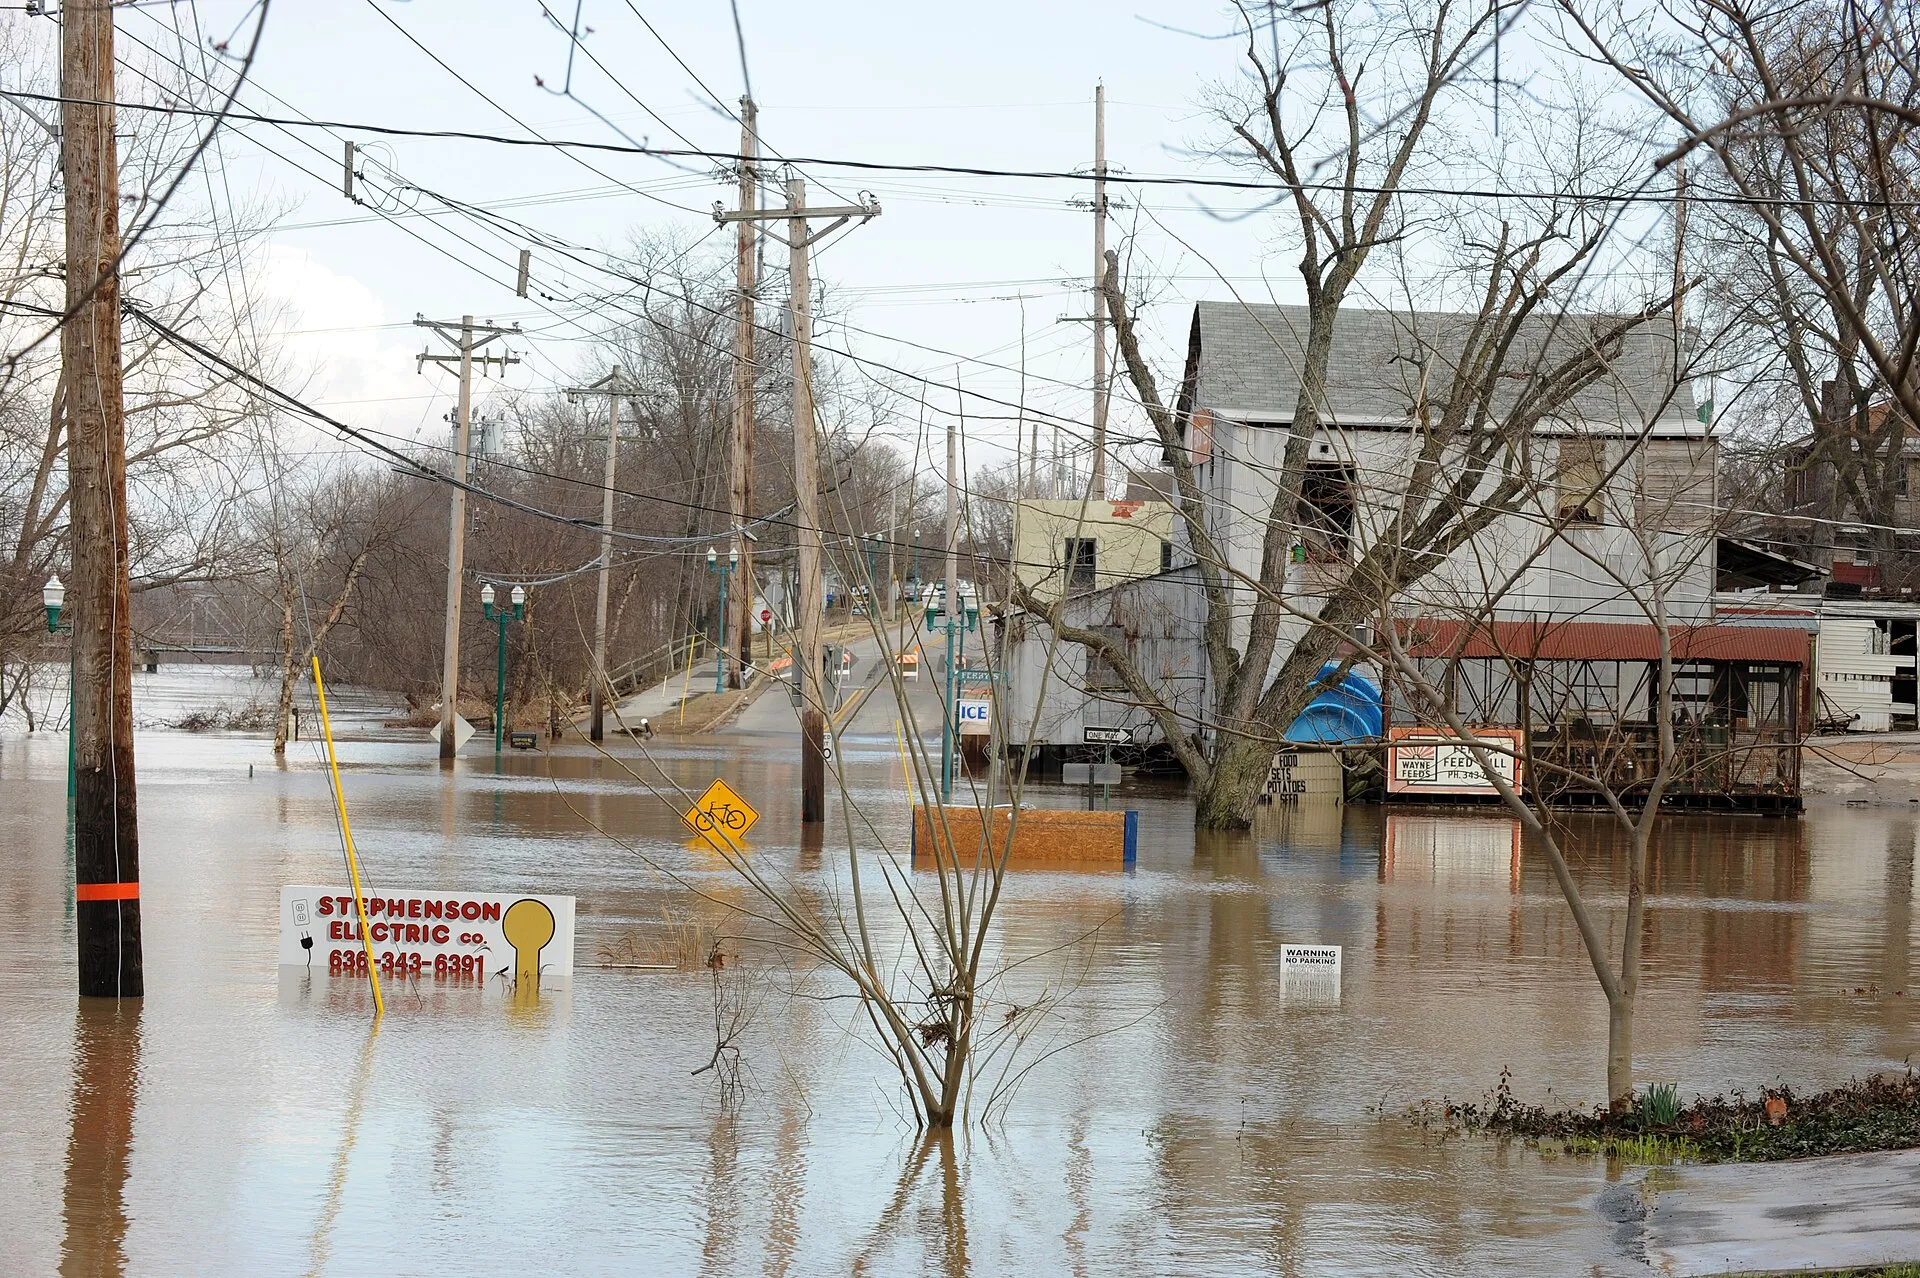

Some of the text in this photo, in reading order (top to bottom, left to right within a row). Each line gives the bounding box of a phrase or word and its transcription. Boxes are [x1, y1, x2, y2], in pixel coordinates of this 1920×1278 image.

[961, 705, 988, 720] ICE
[1279, 755, 1298, 767] FOOD
[1402, 761, 1431, 769] WAYNE
[1443, 757, 1506, 768] FEED ILL
[1271, 768, 1291, 780] SETS
[1402, 770, 1431, 778] FEEDS
[1448, 771, 1461, 779] PH.
[1267, 780, 1306, 793] POTATOES
[319, 895, 501, 921] STEPHENSON
[330, 920, 450, 944] ELECTRIC
[1286, 949, 1336, 957] WARNING
[329, 949, 484, 973] 636-343-6391
